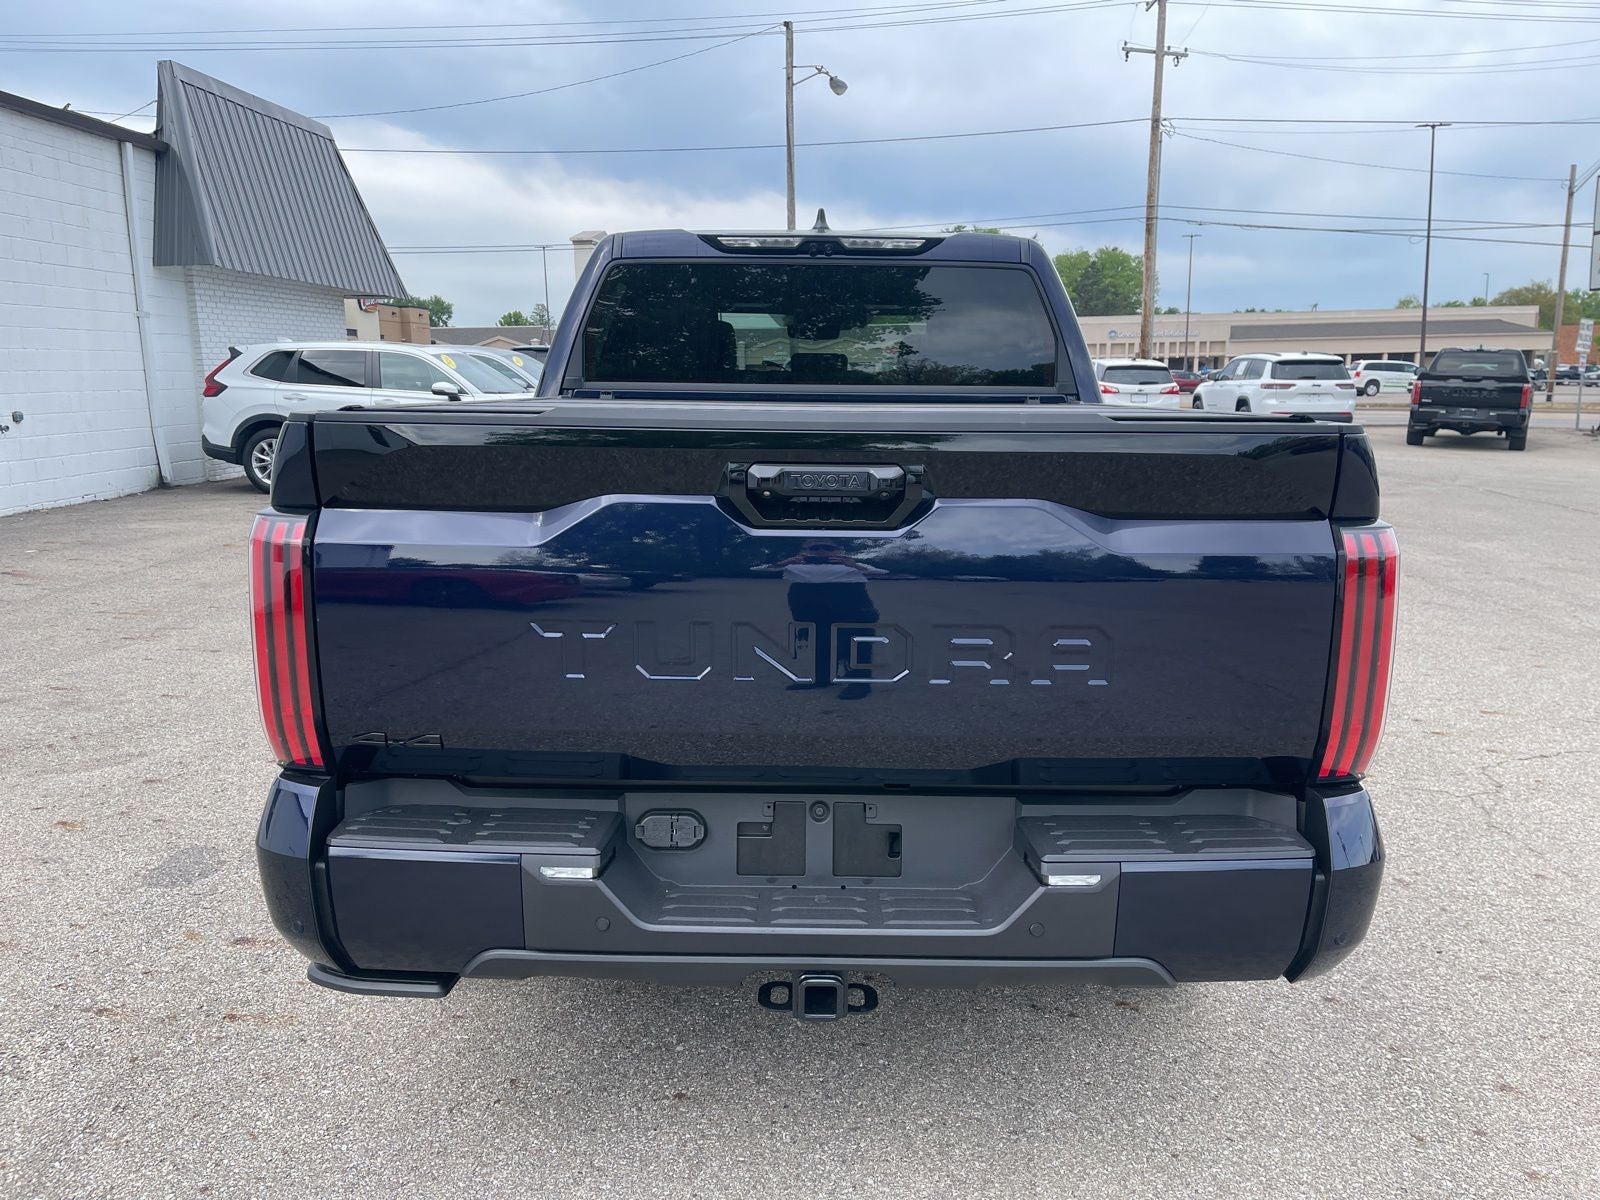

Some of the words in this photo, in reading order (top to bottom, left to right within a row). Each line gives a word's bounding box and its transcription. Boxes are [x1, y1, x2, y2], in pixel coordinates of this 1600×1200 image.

[1442, 389, 1501, 399] TUNDRA
[790, 473, 862, 489] TOYOTA
[528, 620, 1113, 686] TUNDRA
